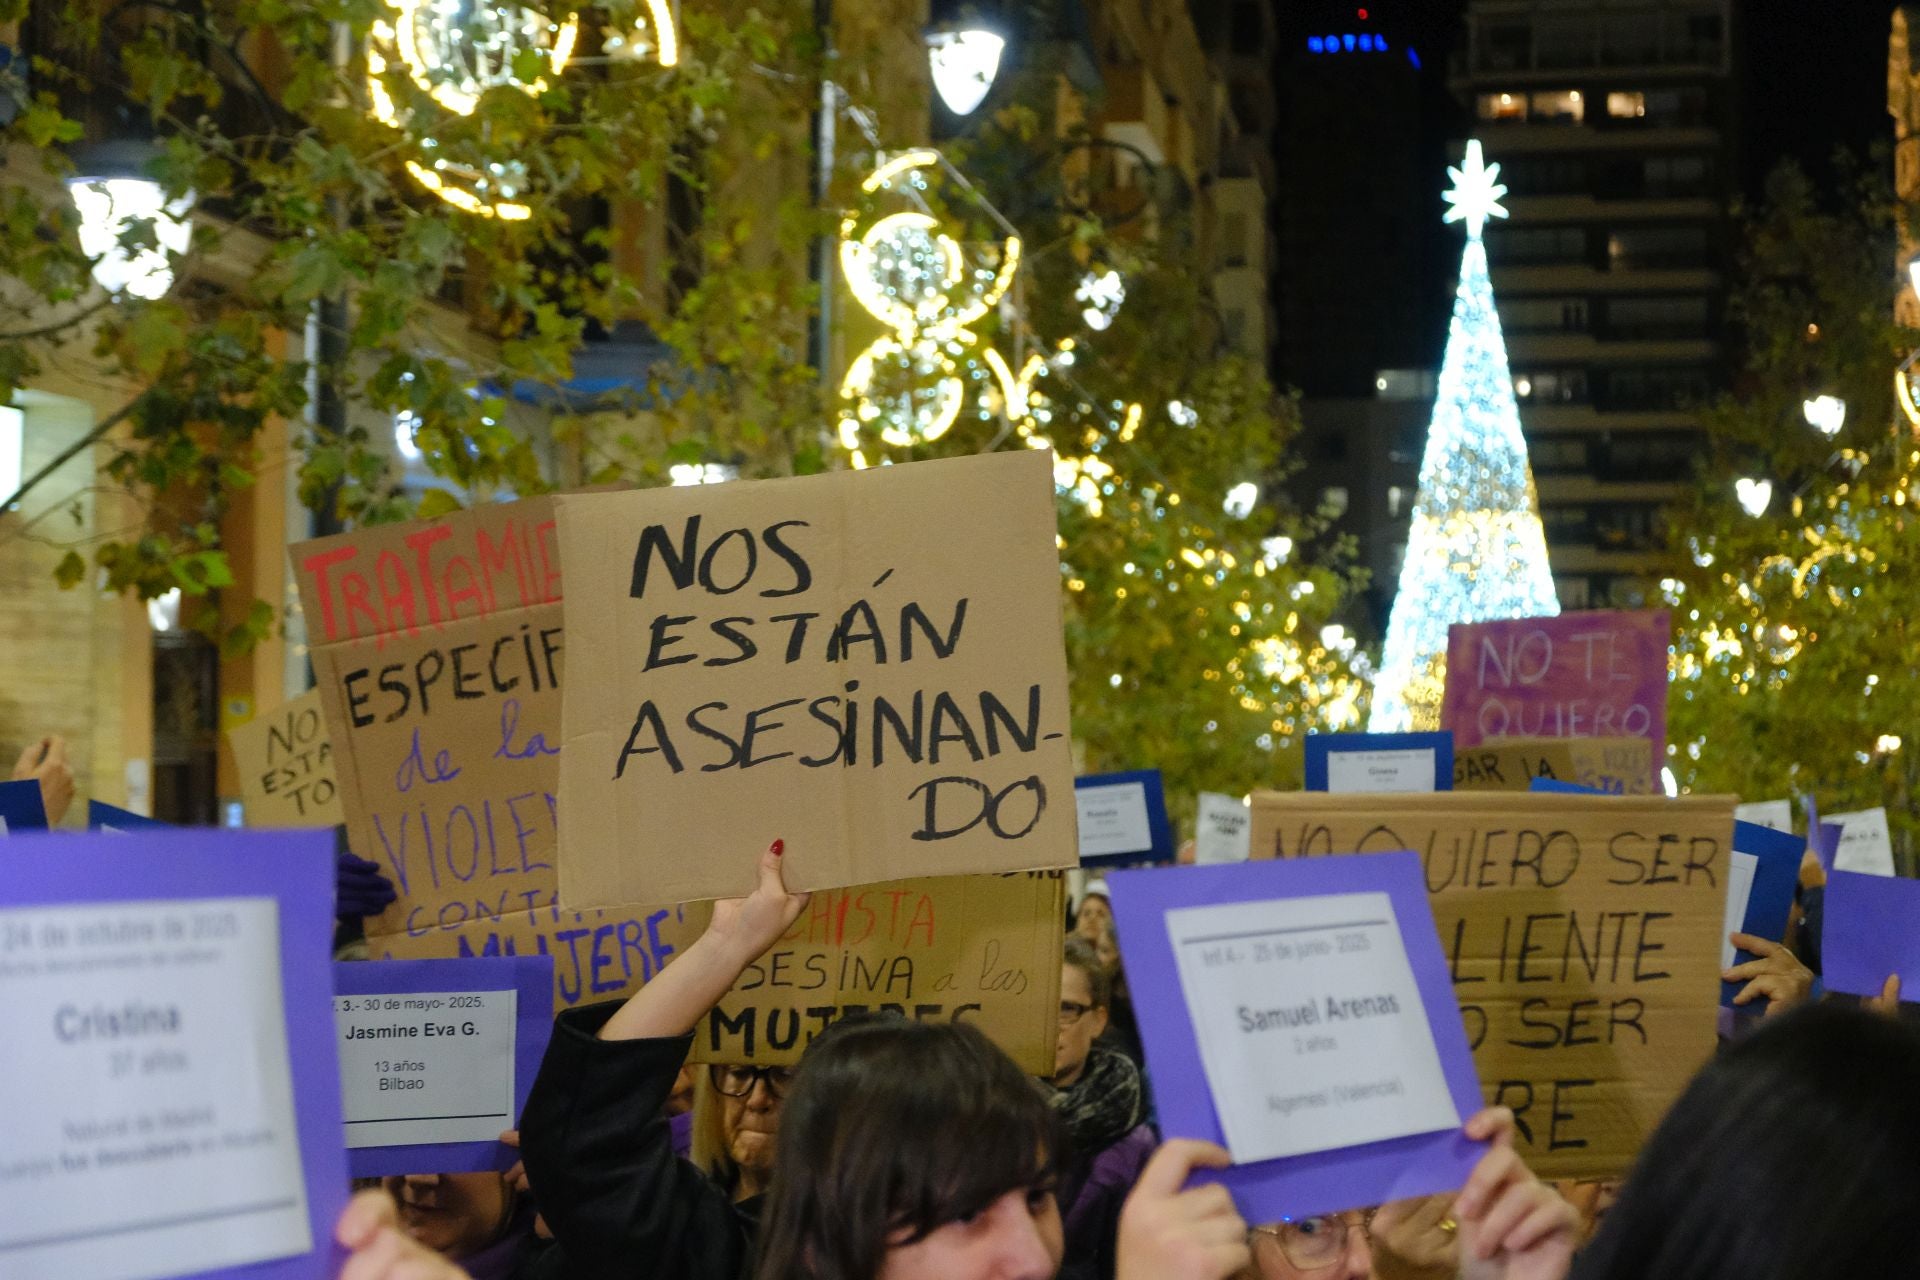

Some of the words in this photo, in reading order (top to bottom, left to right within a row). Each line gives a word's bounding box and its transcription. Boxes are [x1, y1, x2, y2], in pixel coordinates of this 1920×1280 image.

[1308, 33, 1389, 54] HOTEL
[629, 514, 813, 599] NOS
[641, 567, 970, 673] ESTÁN
[1477, 629, 1553, 690] NO
[1569, 631, 1632, 682] TE
[267, 707, 319, 766] NO
[395, 726, 463, 793] de
[493, 698, 561, 760] la
[612, 679, 1064, 781] ASESINAN-
[1478, 698, 1650, 740] QUIERO
[283, 777, 335, 815] TO
[907, 775, 1048, 843] DO
[1608, 830, 1719, 889] SER
[782, 888, 935, 948] HISTA
[727, 950, 914, 999] SESINA
[933, 972, 959, 993] a
[979, 938, 1029, 995] las
[54, 1000, 183, 1045] Cristina
[345, 1024, 419, 1040] Jasmine
[424, 1022, 455, 1038] Eva
[461, 1021, 480, 1036] G.
[363, 999, 381, 1011] 30
[384, 998, 400, 1011] de
[404, 998, 445, 1013] mayo-
[448, 996, 486, 1010] 2025.
[1237, 1000, 1320, 1034] Samuel
[1325, 993, 1401, 1023] Arenas
[1508, 998, 1648, 1049] SER
[374, 1061, 390, 1073] 13
[393, 1060, 425, 1073] años
[378, 1077, 425, 1091] Bilbao
